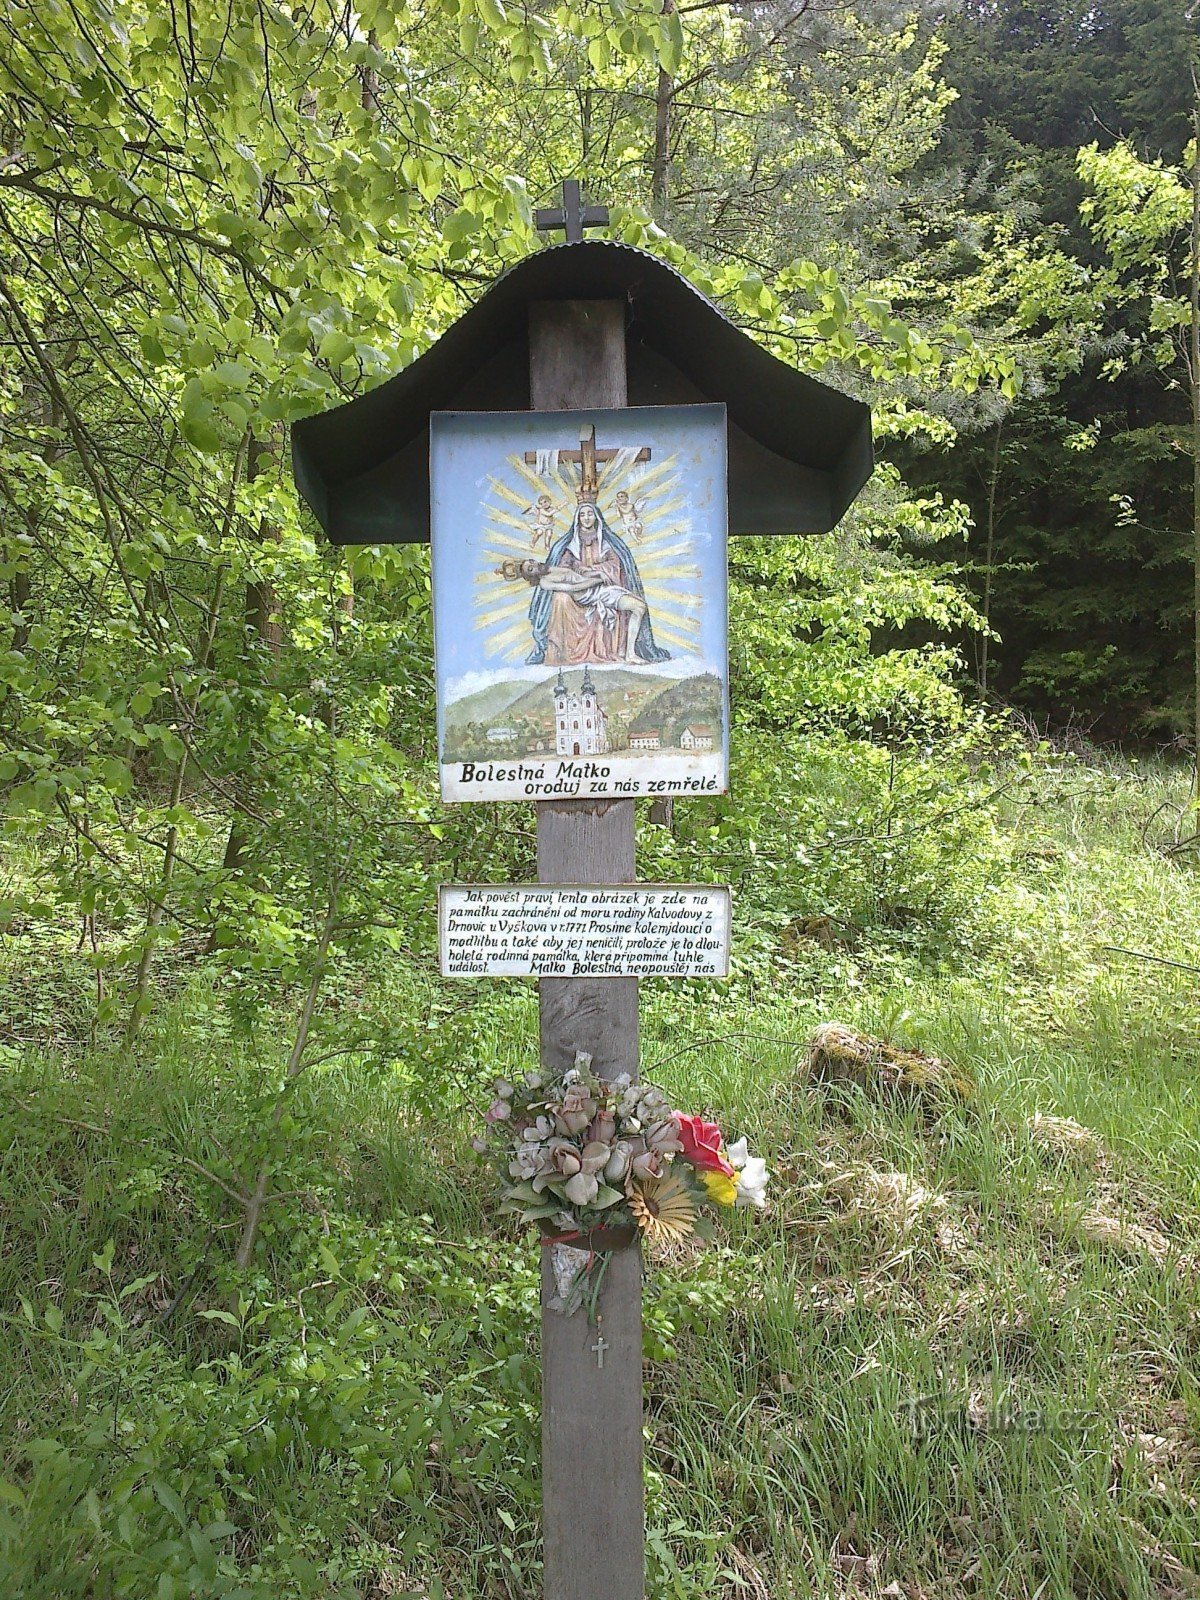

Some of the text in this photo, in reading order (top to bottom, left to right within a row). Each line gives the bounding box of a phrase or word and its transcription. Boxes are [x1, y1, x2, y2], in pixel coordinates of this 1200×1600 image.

[458, 761, 611, 783] Bolestná Matko
[524, 774, 719, 795] oroduj za nás zemřelé.
[464, 890, 484, 902] Jak
[486, 891, 519, 904] pověst
[591, 891, 640, 905] obrázek
[642, 892, 655, 906] je
[661, 892, 687, 905] zde
[692, 896, 708, 905] na
[448, 905, 713, 921] památku zachránění od moru rodiny Kalvodovy z
[447, 919, 487, 932] Drnovic
[489, 923, 497, 932] u
[498, 919, 547, 935] Vyškova
[550, 923, 557, 932] v
[588, 920, 631, 933] Prosíme
[634, 921, 704, 936] kolemjdoucí
[704, 924, 712, 933] o
[448, 935, 499, 947] modlitbu
[500, 938, 508, 947] a
[512, 934, 539, 948] také
[542, 936, 564, 950] aby
[566, 936, 584, 950] jej
[625, 937, 668, 950] protože
[670, 937, 681, 950] je
[682, 937, 693, 950] to
[694, 937, 724, 950] dlou-
[448, 948, 484, 961] holetá
[486, 949, 530, 961] rodinná
[583, 949, 612, 962] která
[673, 950, 704, 962] tuhle
[529, 961, 566, 974] Matko
[626, 961, 691, 975] neopouštěj
[694, 961, 716, 974] nás
